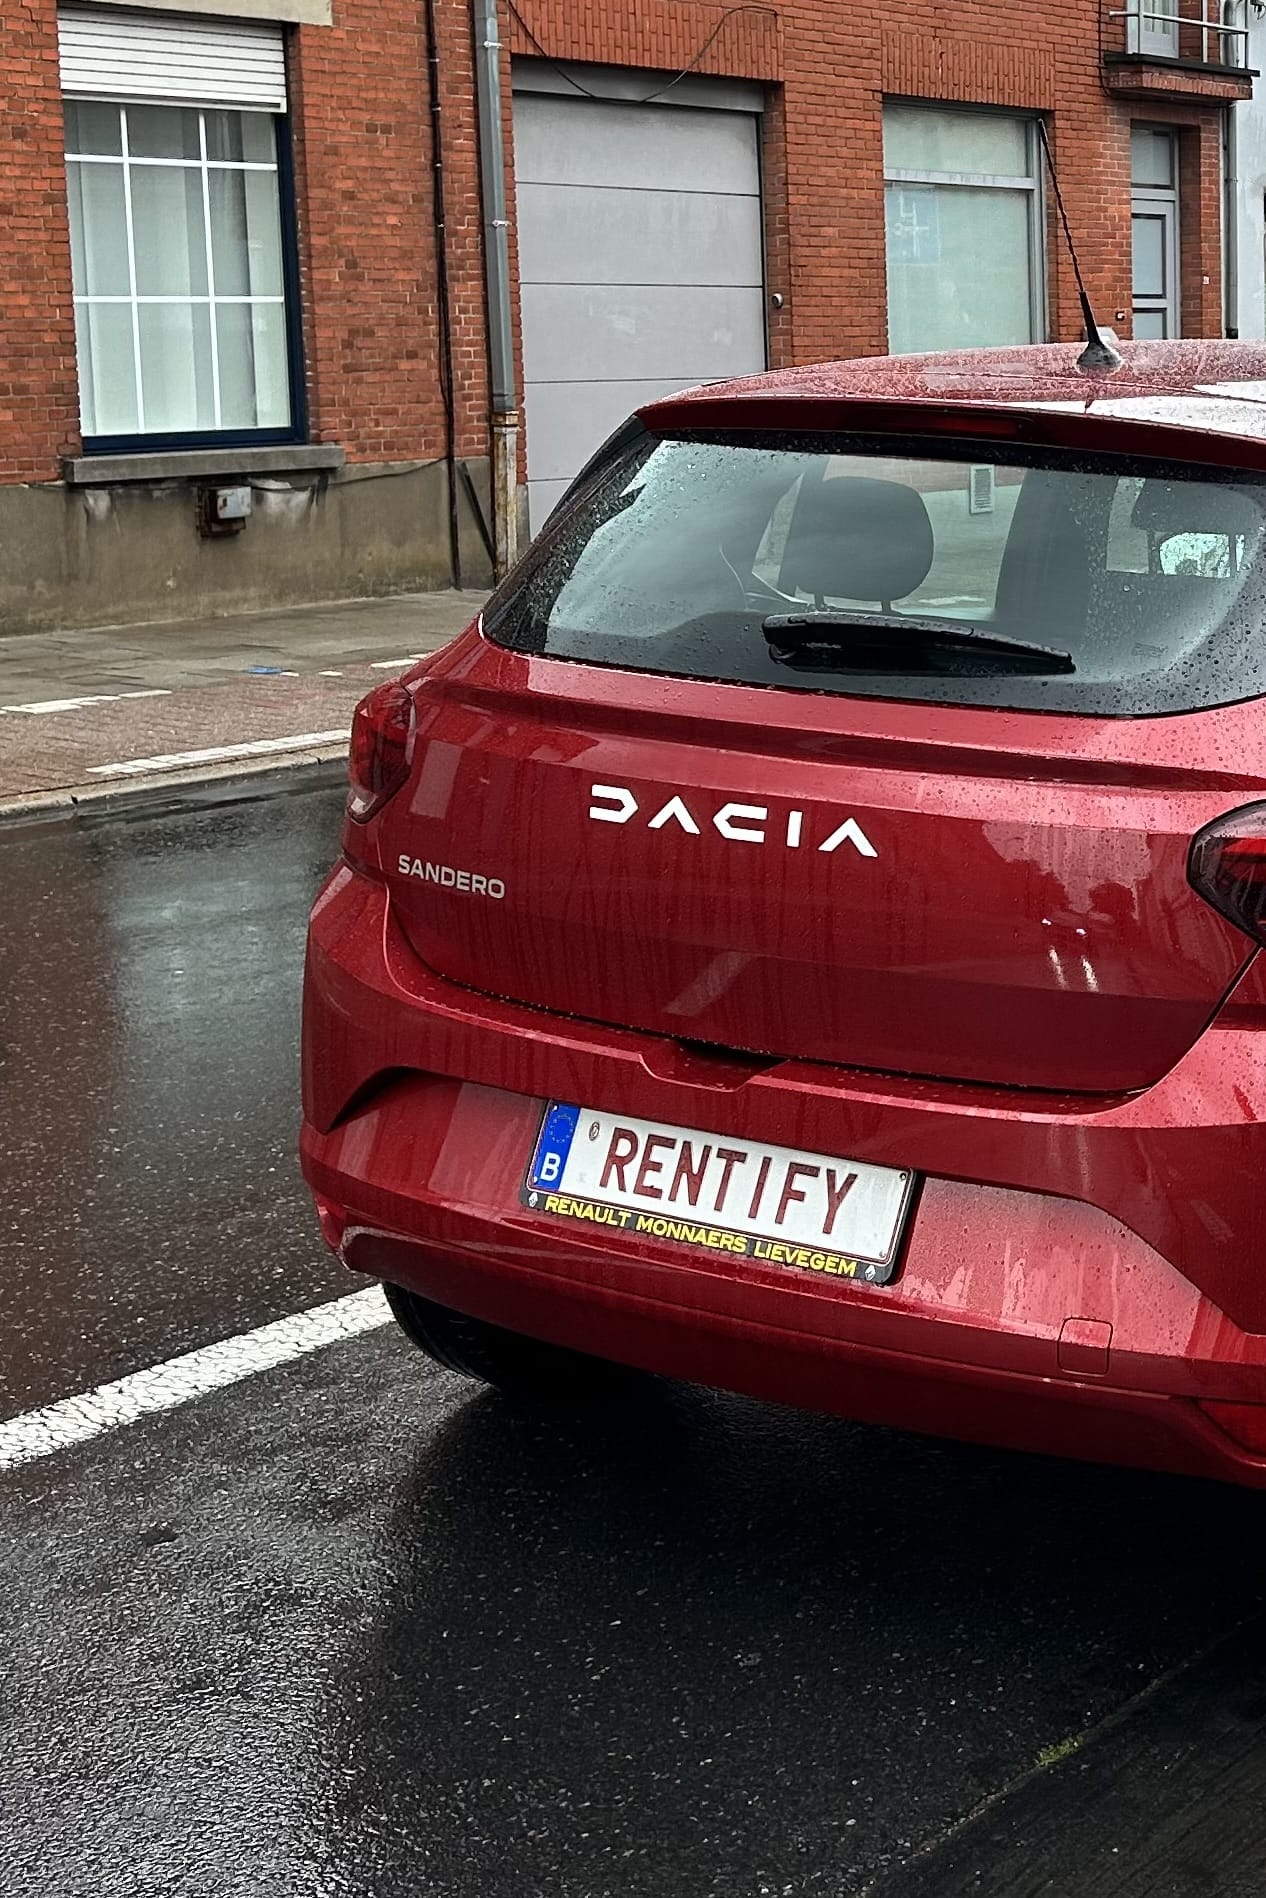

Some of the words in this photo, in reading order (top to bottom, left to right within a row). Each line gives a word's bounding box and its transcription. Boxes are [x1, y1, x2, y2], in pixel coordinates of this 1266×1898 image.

[589, 784, 878, 857] DACIA
[398, 854, 505, 899] SANDERO
[541, 1153, 561, 1182] B
[599, 1128, 858, 1234] RENTIFY
[544, 1196, 630, 1227] RENAULT
[635, 1215, 747, 1254] MONNAERS
[753, 1240, 857, 1277] LIEVEGEM
